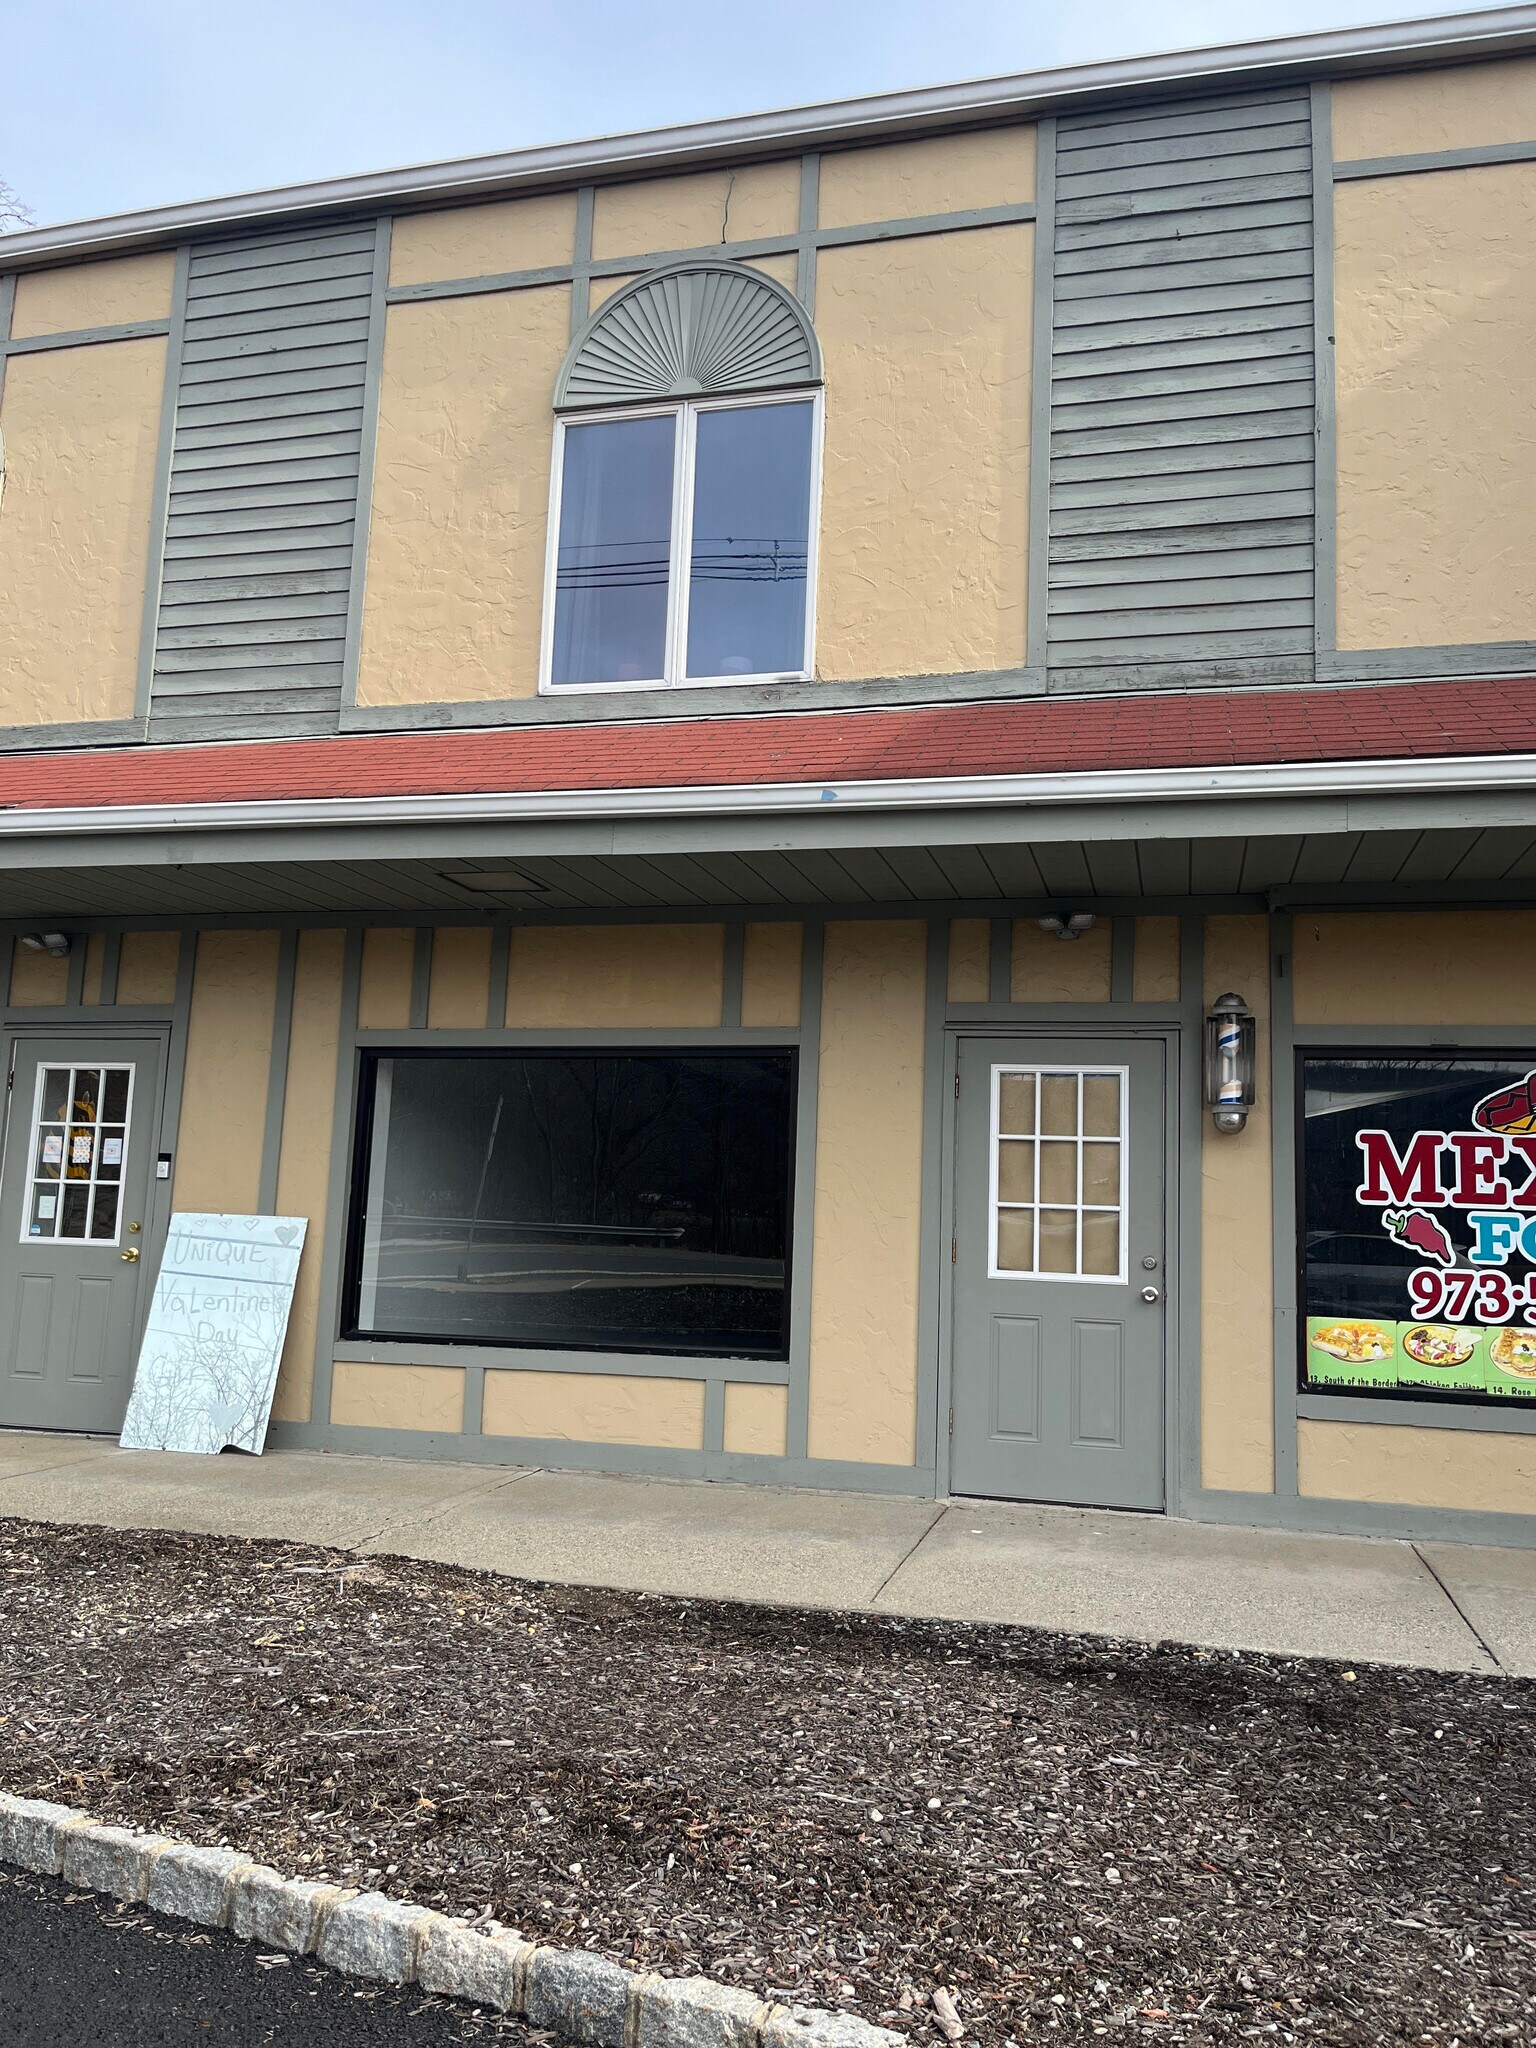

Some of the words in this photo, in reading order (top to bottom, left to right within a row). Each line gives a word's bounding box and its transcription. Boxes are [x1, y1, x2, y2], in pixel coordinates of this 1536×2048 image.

[197, 1321, 239, 1351] Day
[1324, 1375, 1345, 1385] South
[1347, 1377, 1356, 1385] of
[1358, 1377, 1369, 1387] the
[1372, 1378, 1397, 1388] Border
[1492, 1386, 1507, 1395] 14.
[1511, 1387, 1531, 1396] Rose
